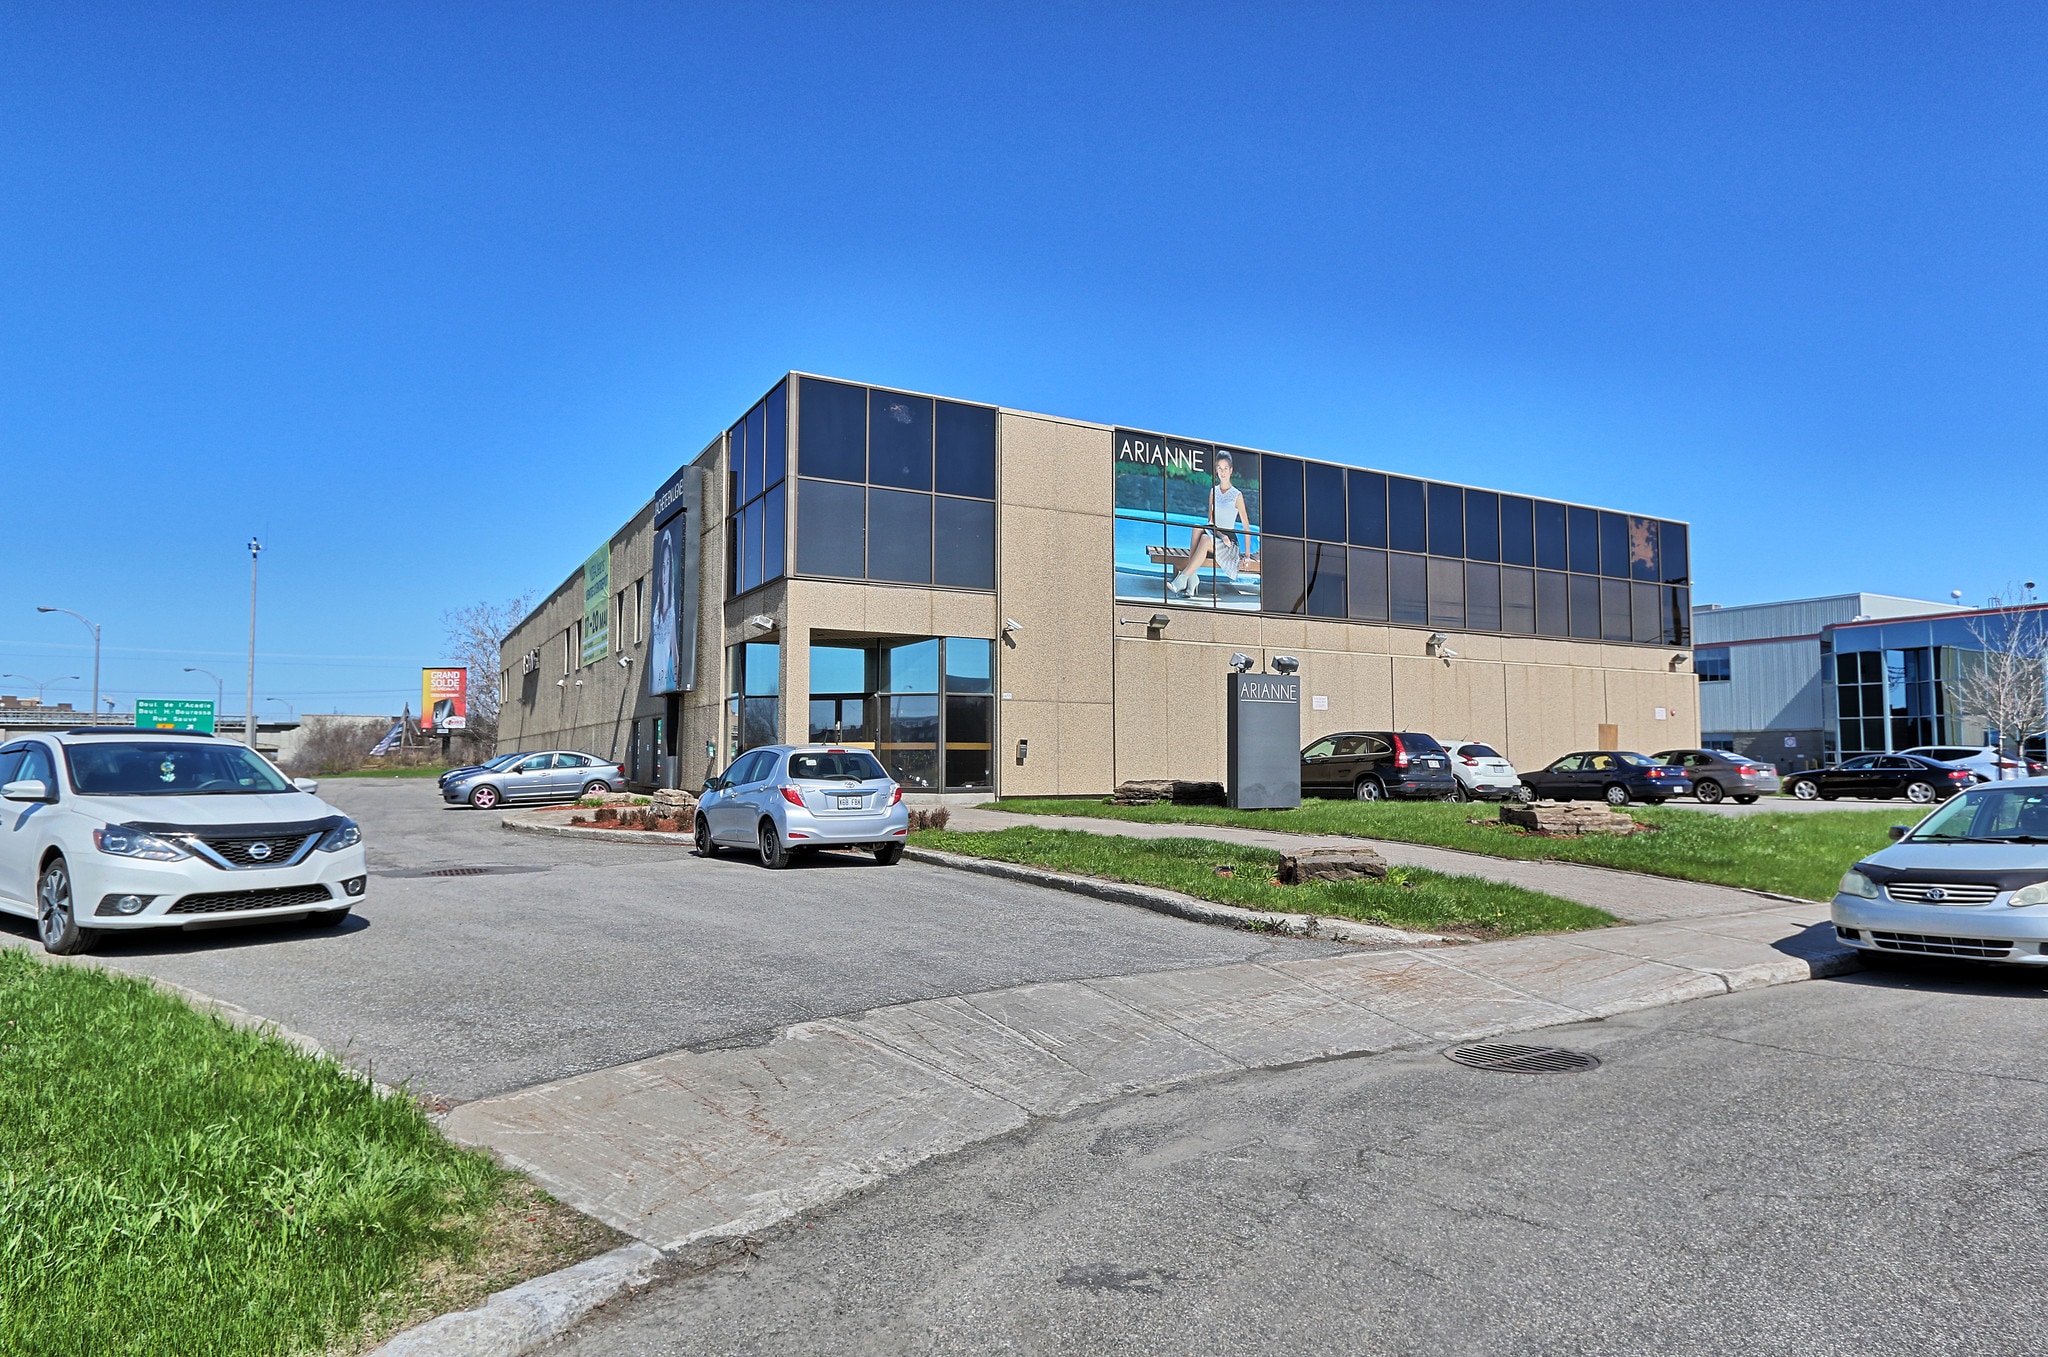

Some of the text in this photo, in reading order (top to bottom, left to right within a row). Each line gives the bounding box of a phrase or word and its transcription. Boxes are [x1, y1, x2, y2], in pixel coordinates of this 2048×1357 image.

[1119, 439, 1204, 472] ARIANNE
[431, 671, 460, 679] GRAND
[431, 679, 460, 687] SOLDE
[1240, 682, 1297, 700] ARIANNE
